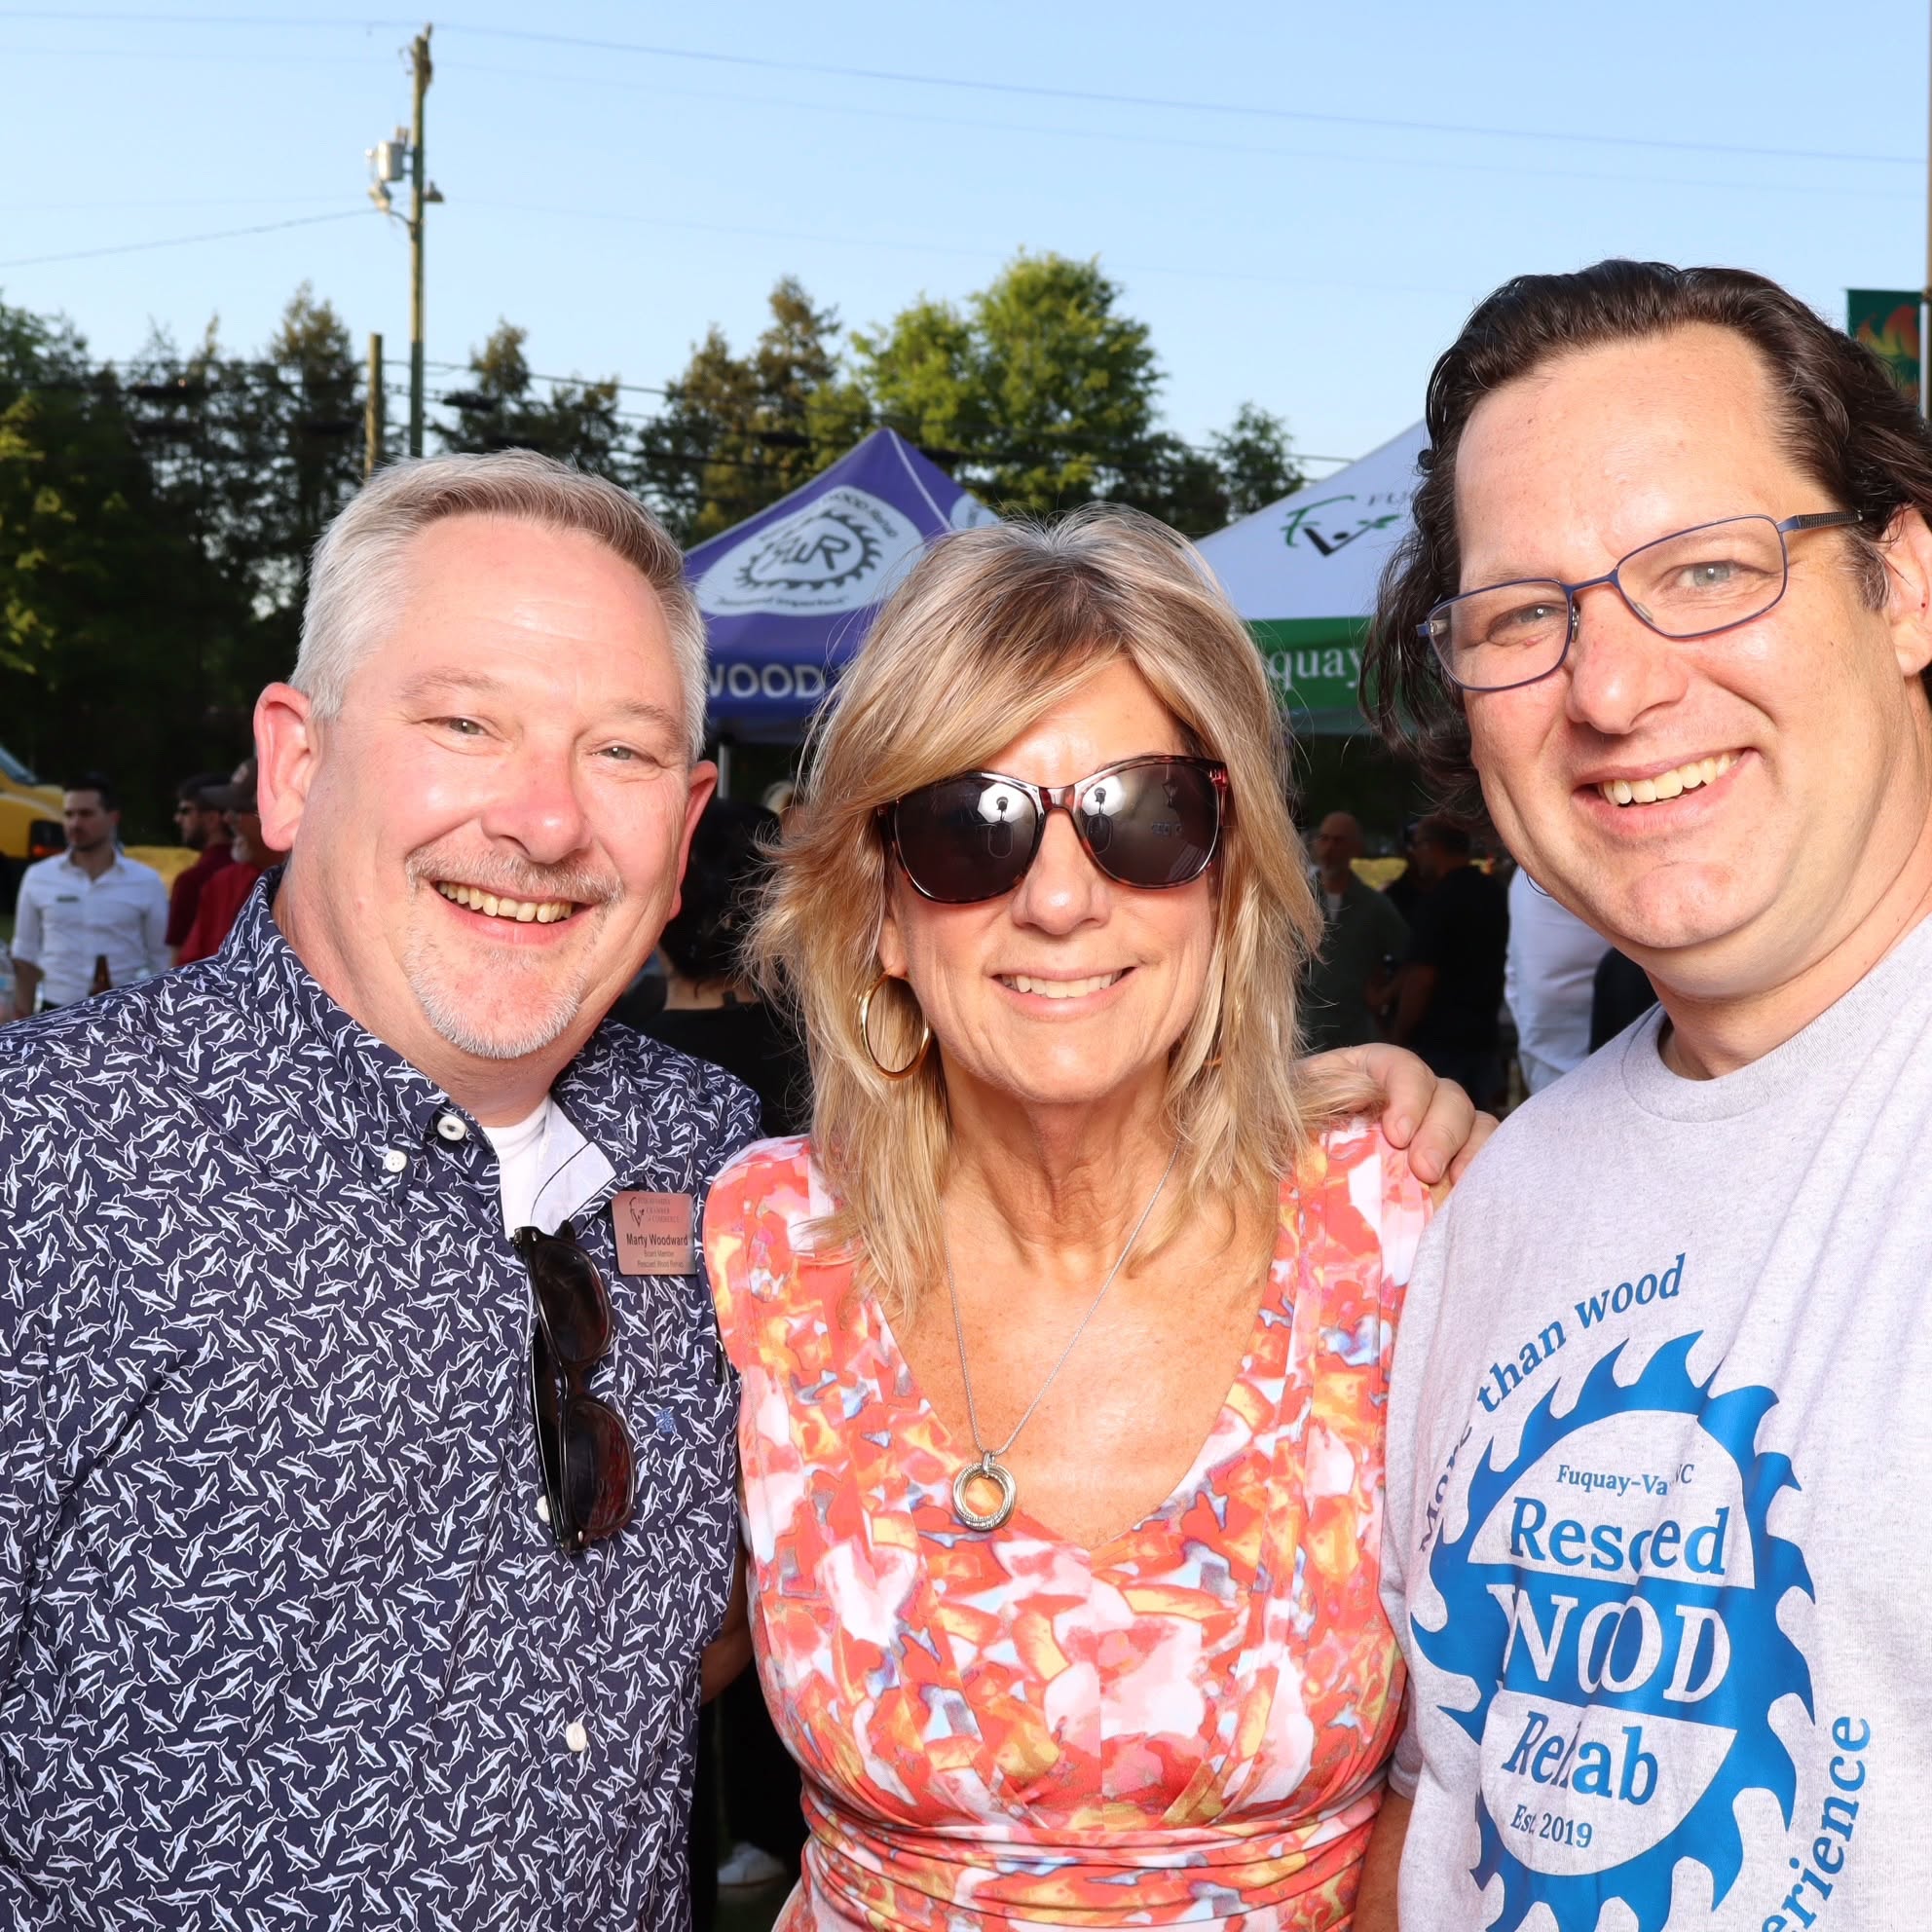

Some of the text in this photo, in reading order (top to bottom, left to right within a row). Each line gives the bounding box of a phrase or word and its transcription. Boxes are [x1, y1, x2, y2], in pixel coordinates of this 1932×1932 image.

[1269, 648, 1362, 691] quay
[626, 1233, 688, 1248] Marty Woodward
[1476, 1319, 1567, 1413] than
[1574, 1252, 1687, 1330] wood
[1556, 1464, 1669, 1498] Fuquay-Va
[1511, 1496, 1730, 1576] Resced
[1539, 1812, 1593, 1848] 2019
[1762, 1716, 1871, 1932] erience
